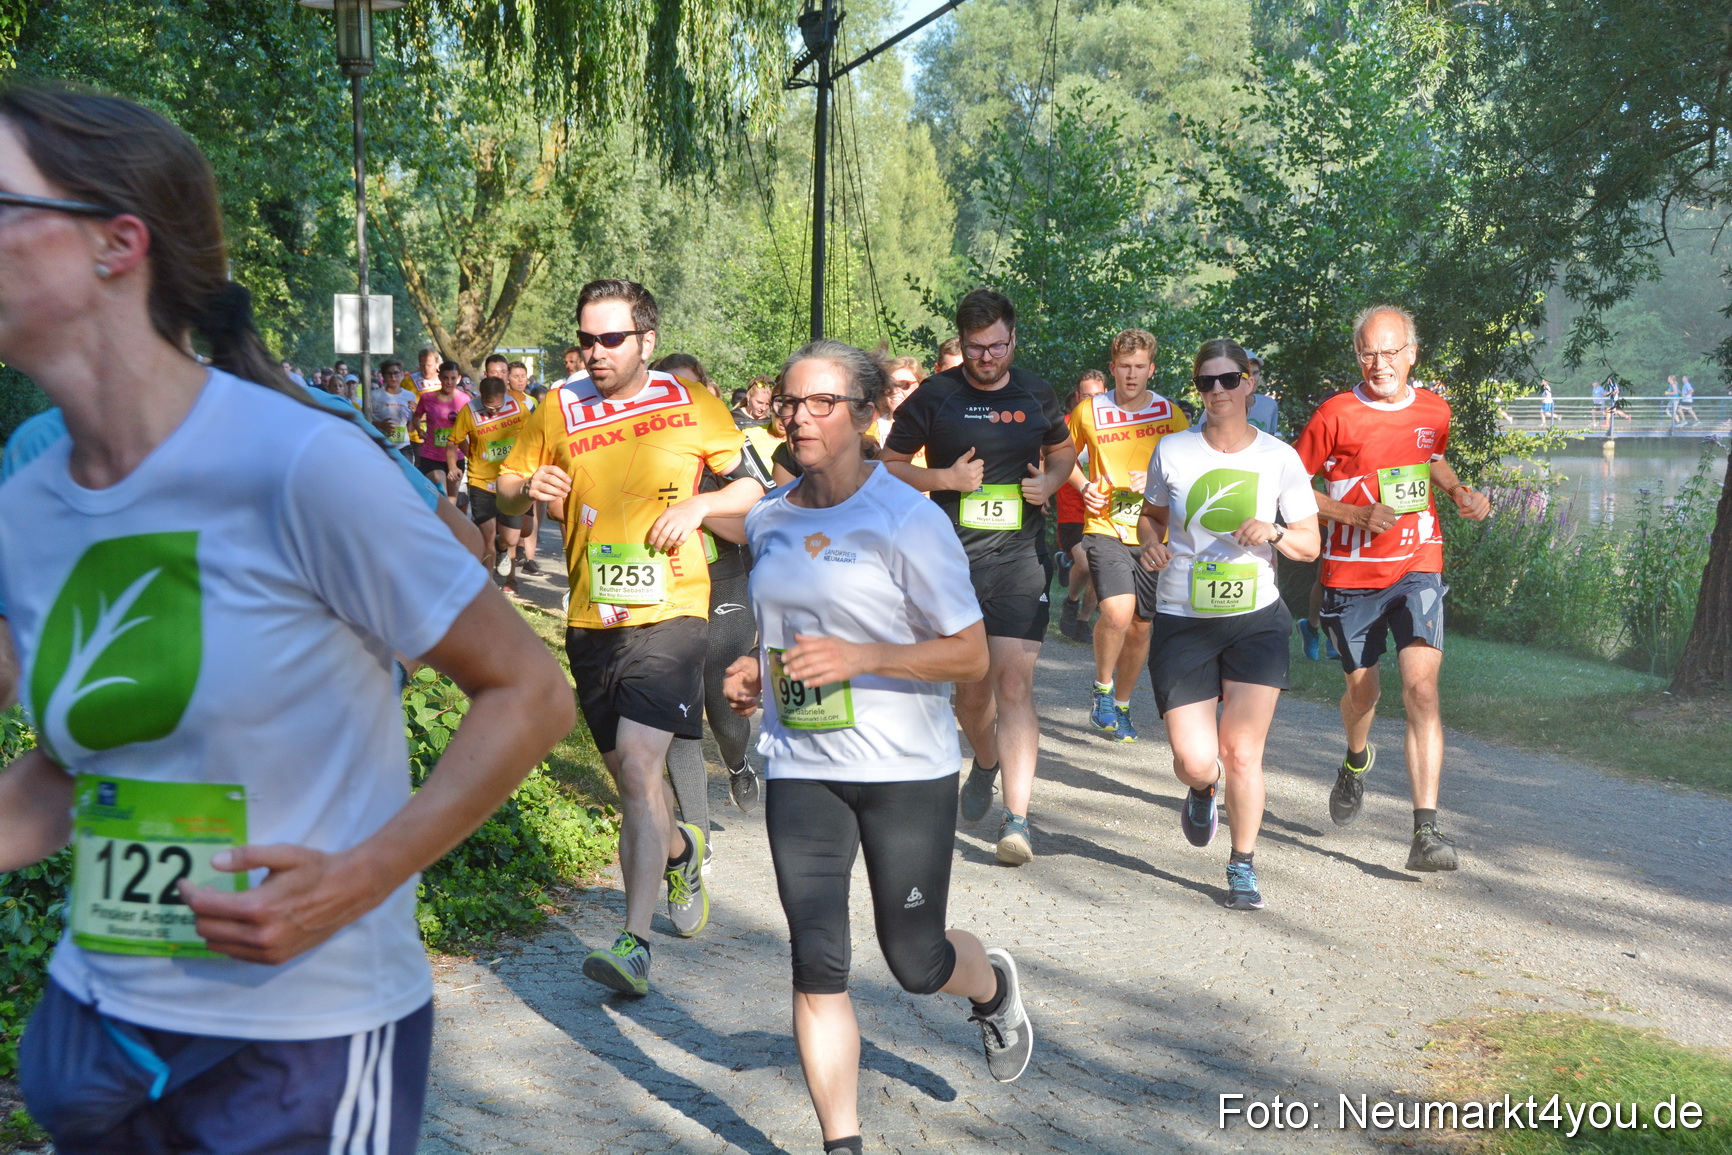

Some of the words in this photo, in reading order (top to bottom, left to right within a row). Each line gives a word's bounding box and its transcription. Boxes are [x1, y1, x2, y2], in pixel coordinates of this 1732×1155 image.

[476, 424, 498, 436] MAX
[568, 428, 626, 458] MAX
[632, 412, 698, 438] BÖGL
[1096, 430, 1131, 445] MAX
[1136, 424, 1174, 439] BÖGL
[1395, 480, 1426, 500] 548
[980, 500, 1003, 517] 15
[823, 555, 857, 564] NEUMARKT
[824, 549, 857, 558] LANDKREIS
[597, 564, 656, 587] 1253
[1207, 580, 1244, 599] 123
[796, 707, 825, 715] Gabriele
[96, 838, 193, 905] 122
